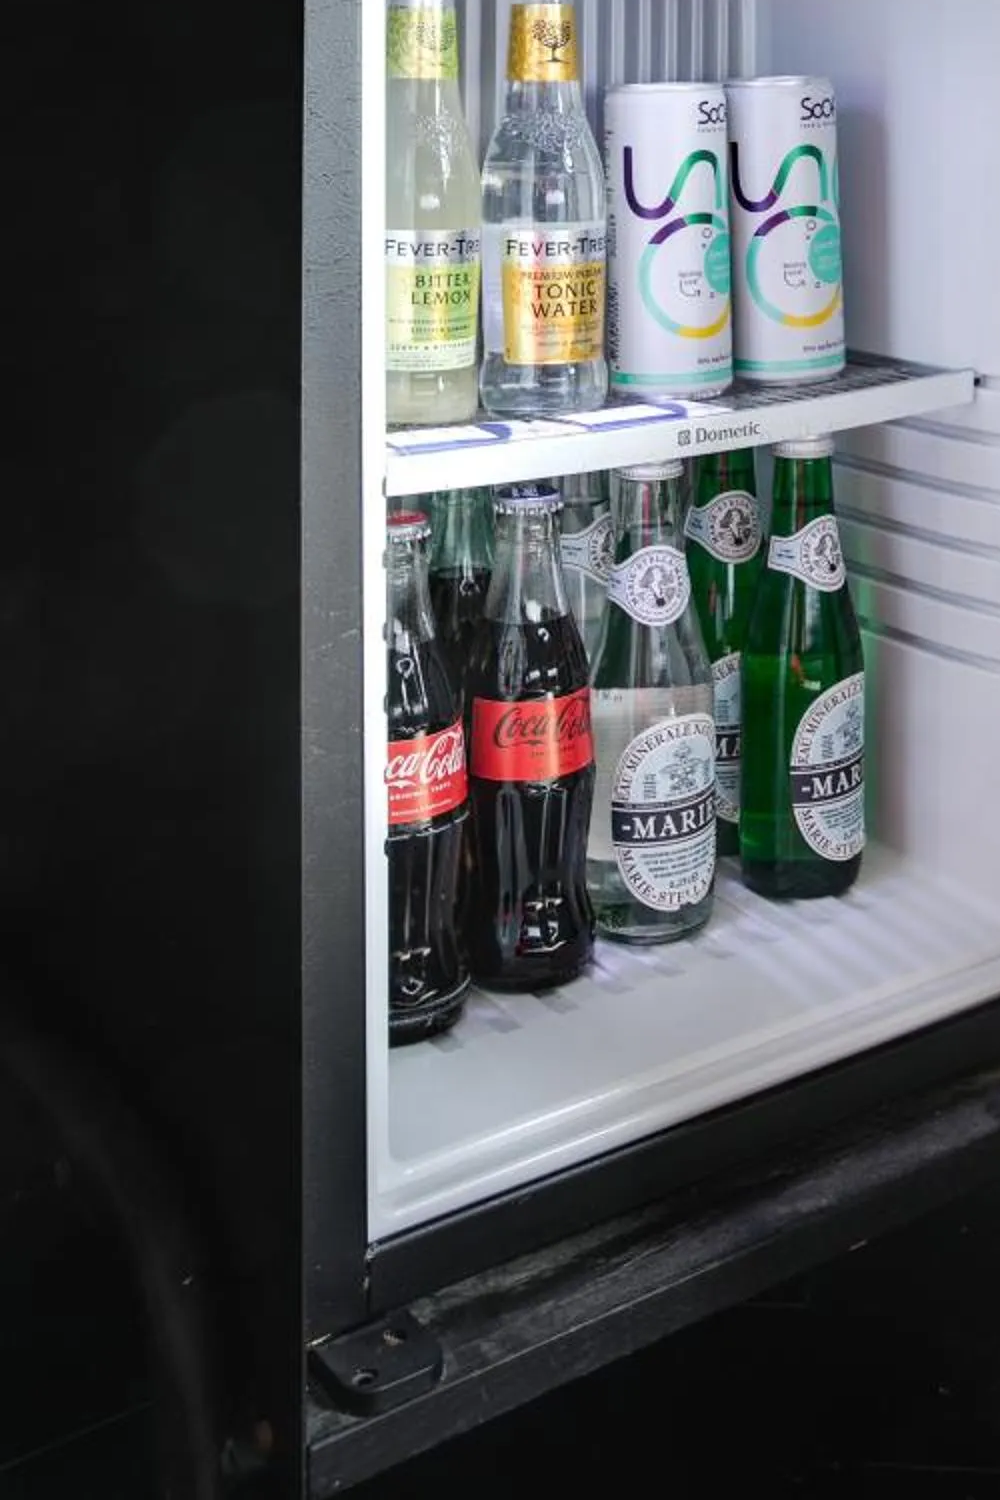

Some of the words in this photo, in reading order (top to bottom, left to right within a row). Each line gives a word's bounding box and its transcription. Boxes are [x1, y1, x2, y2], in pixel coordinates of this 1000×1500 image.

[414, 273, 471, 289] BITTER
[534, 280, 596, 299] TONIC
[411, 292, 471, 305] LEMON
[531, 299, 598, 319] WATER
[695, 421, 761, 444] Dometic
